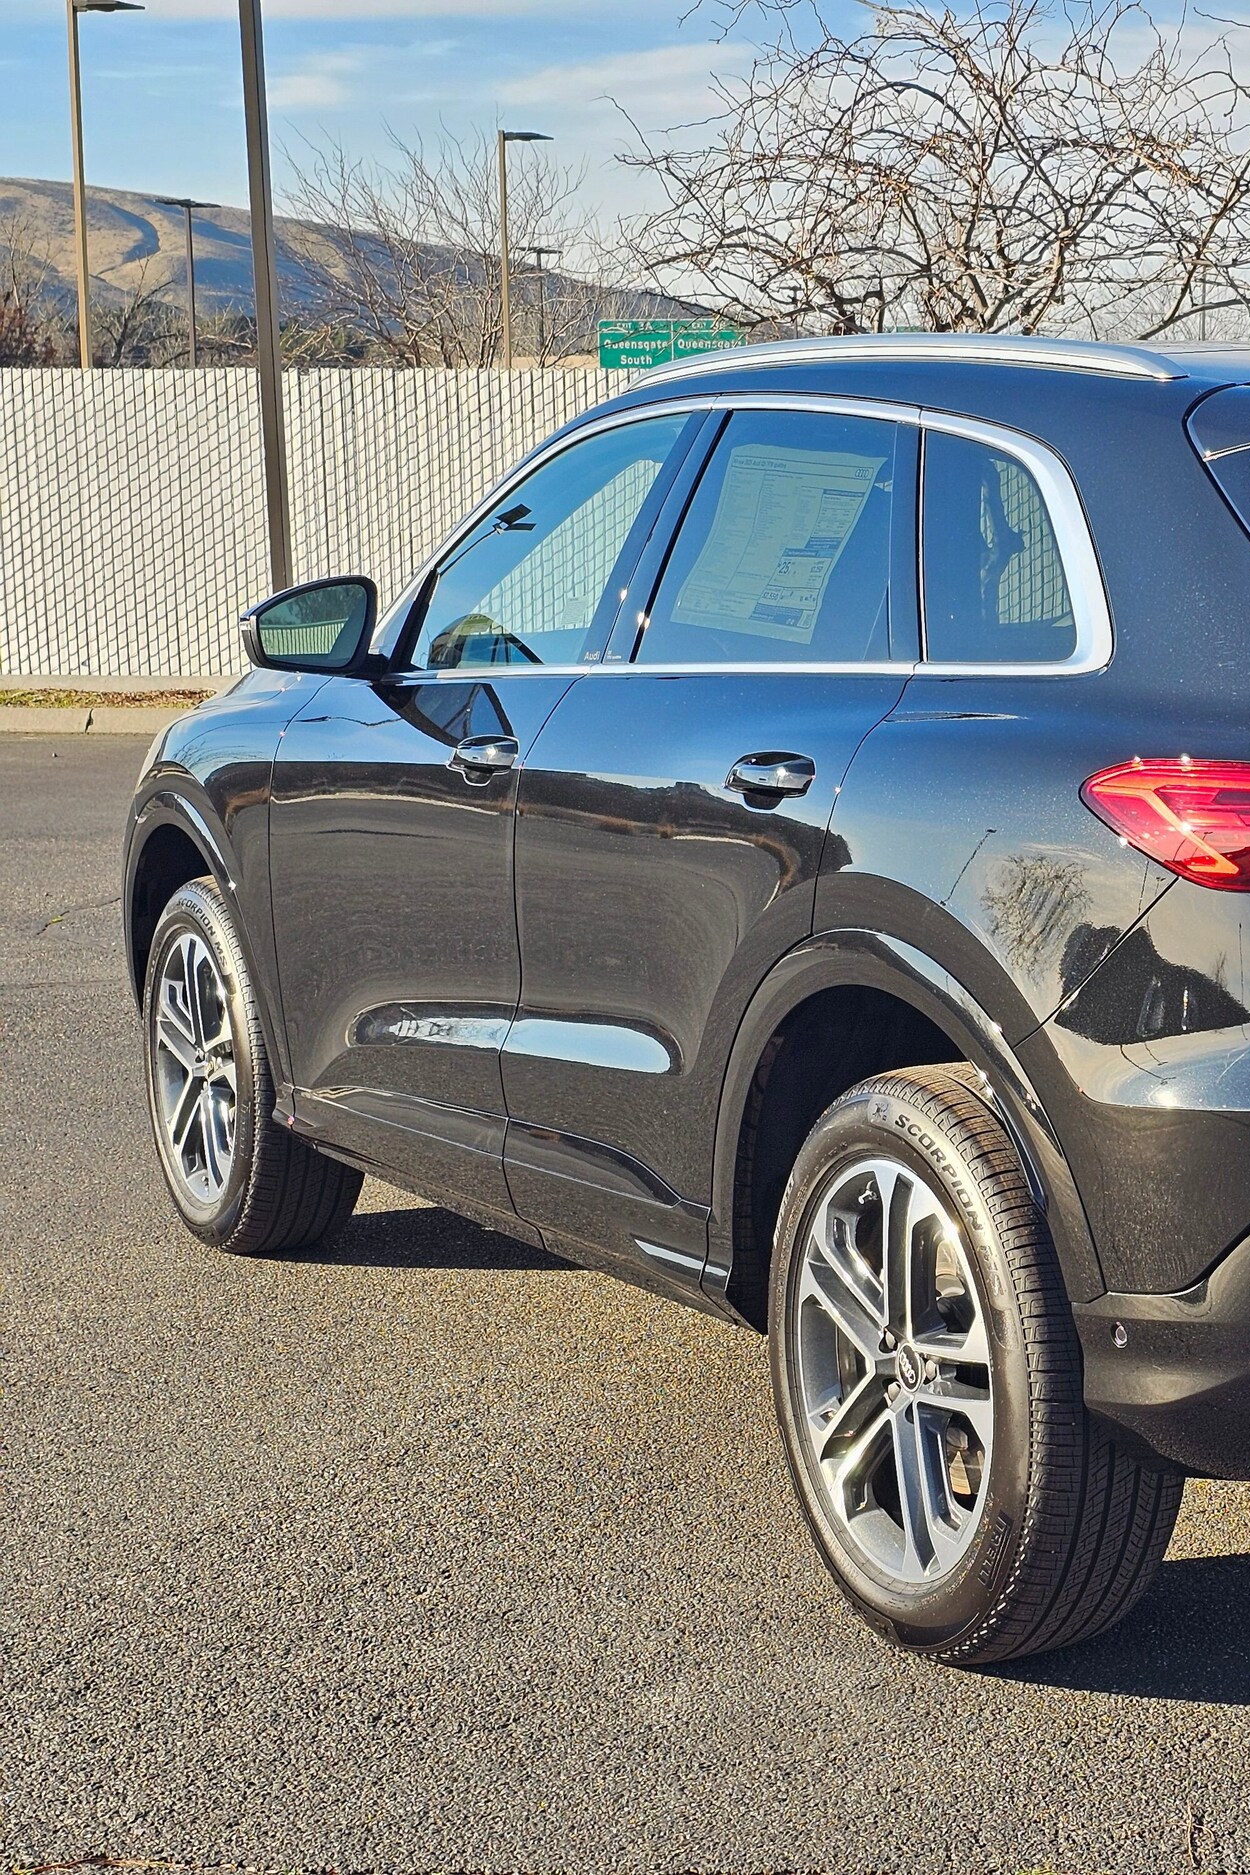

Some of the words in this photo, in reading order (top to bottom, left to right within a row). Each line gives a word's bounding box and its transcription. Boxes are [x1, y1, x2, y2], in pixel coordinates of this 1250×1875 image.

[604, 339, 668, 351] Queensgate
[620, 355, 652, 365] South
[584, 650, 600, 661] Audi
[176, 897, 216, 936] SCORPION
[894, 1113, 984, 1232] SCORPION
